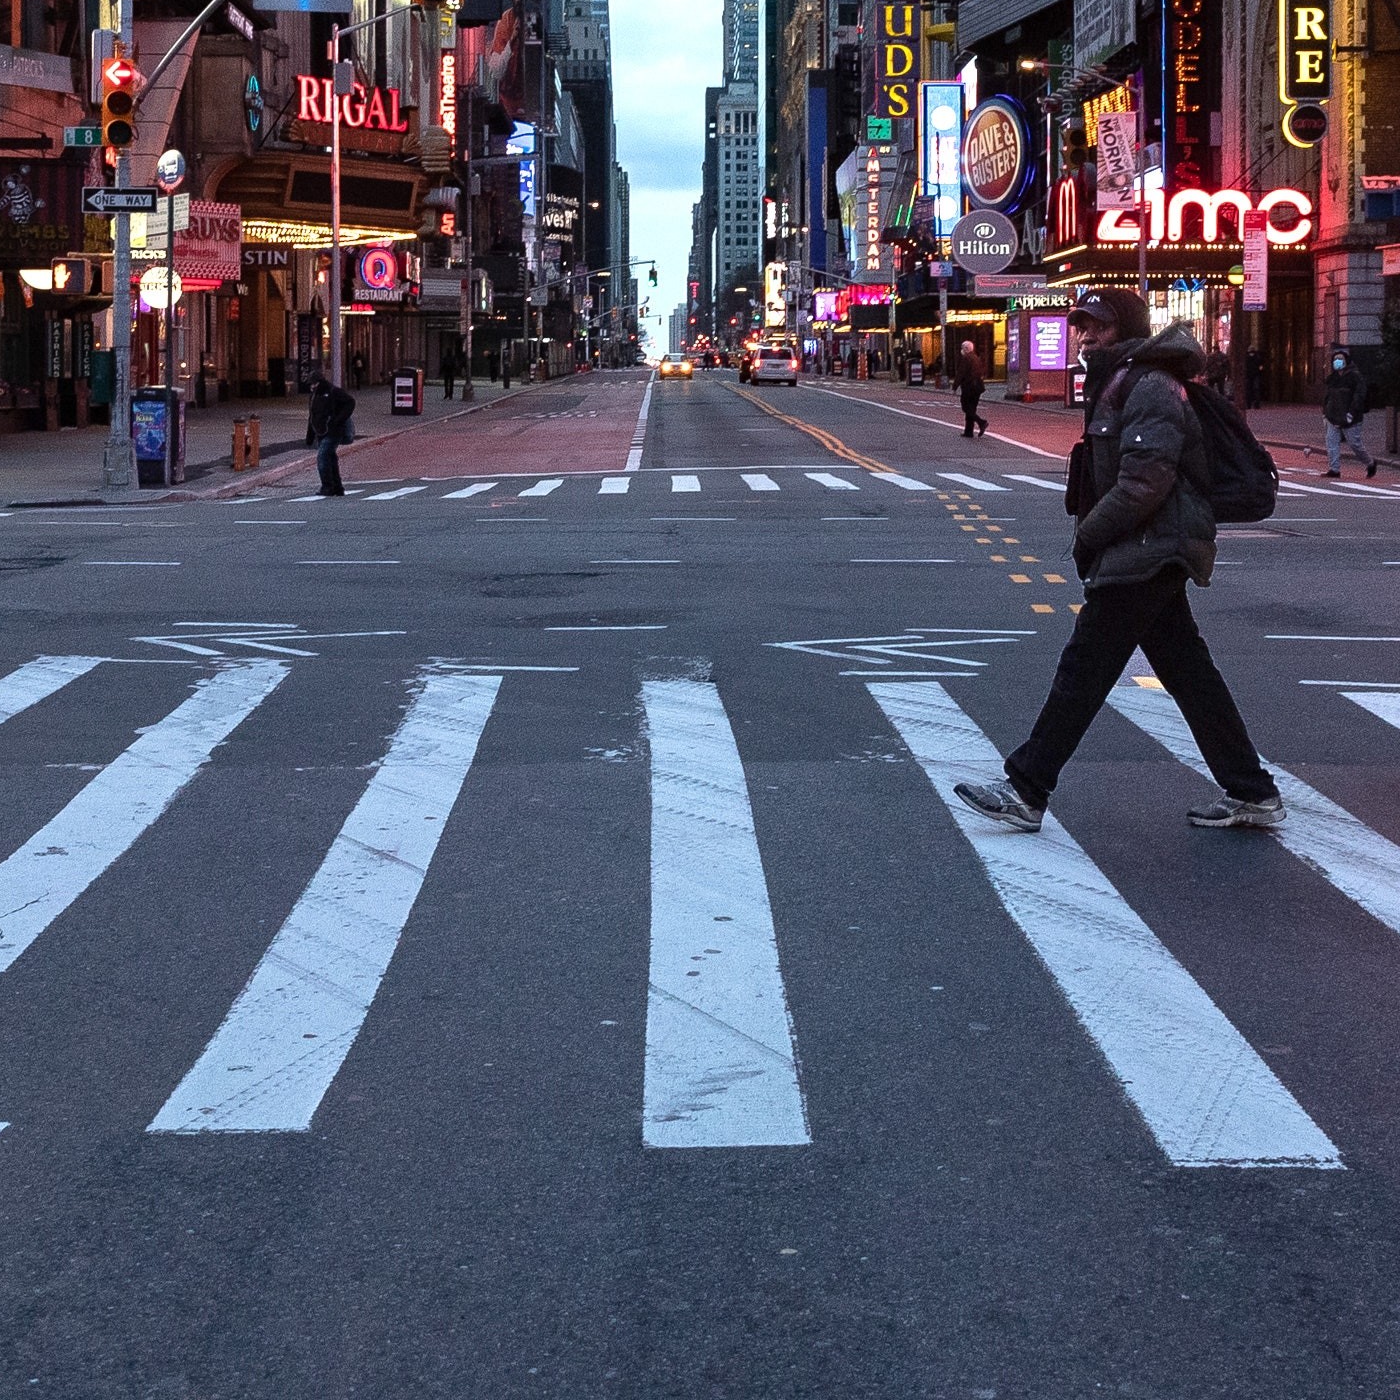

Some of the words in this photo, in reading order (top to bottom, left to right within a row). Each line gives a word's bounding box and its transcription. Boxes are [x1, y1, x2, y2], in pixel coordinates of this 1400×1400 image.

[84, 129, 94, 145] 8
[969, 122, 1003, 162] DAVE
[1001, 120, 1016, 145] &
[971, 146, 1016, 188] BUSTER'S
[1099, 118, 1133, 203] MORMON
[94, 195, 116, 206] ONE
[125, 195, 149, 206] WAY
[182, 216, 241, 242] GUYS
[959, 240, 1011, 256] Hilton
[243, 249, 289, 266] STIN
[354, 288, 404, 302] RESTAURANT
